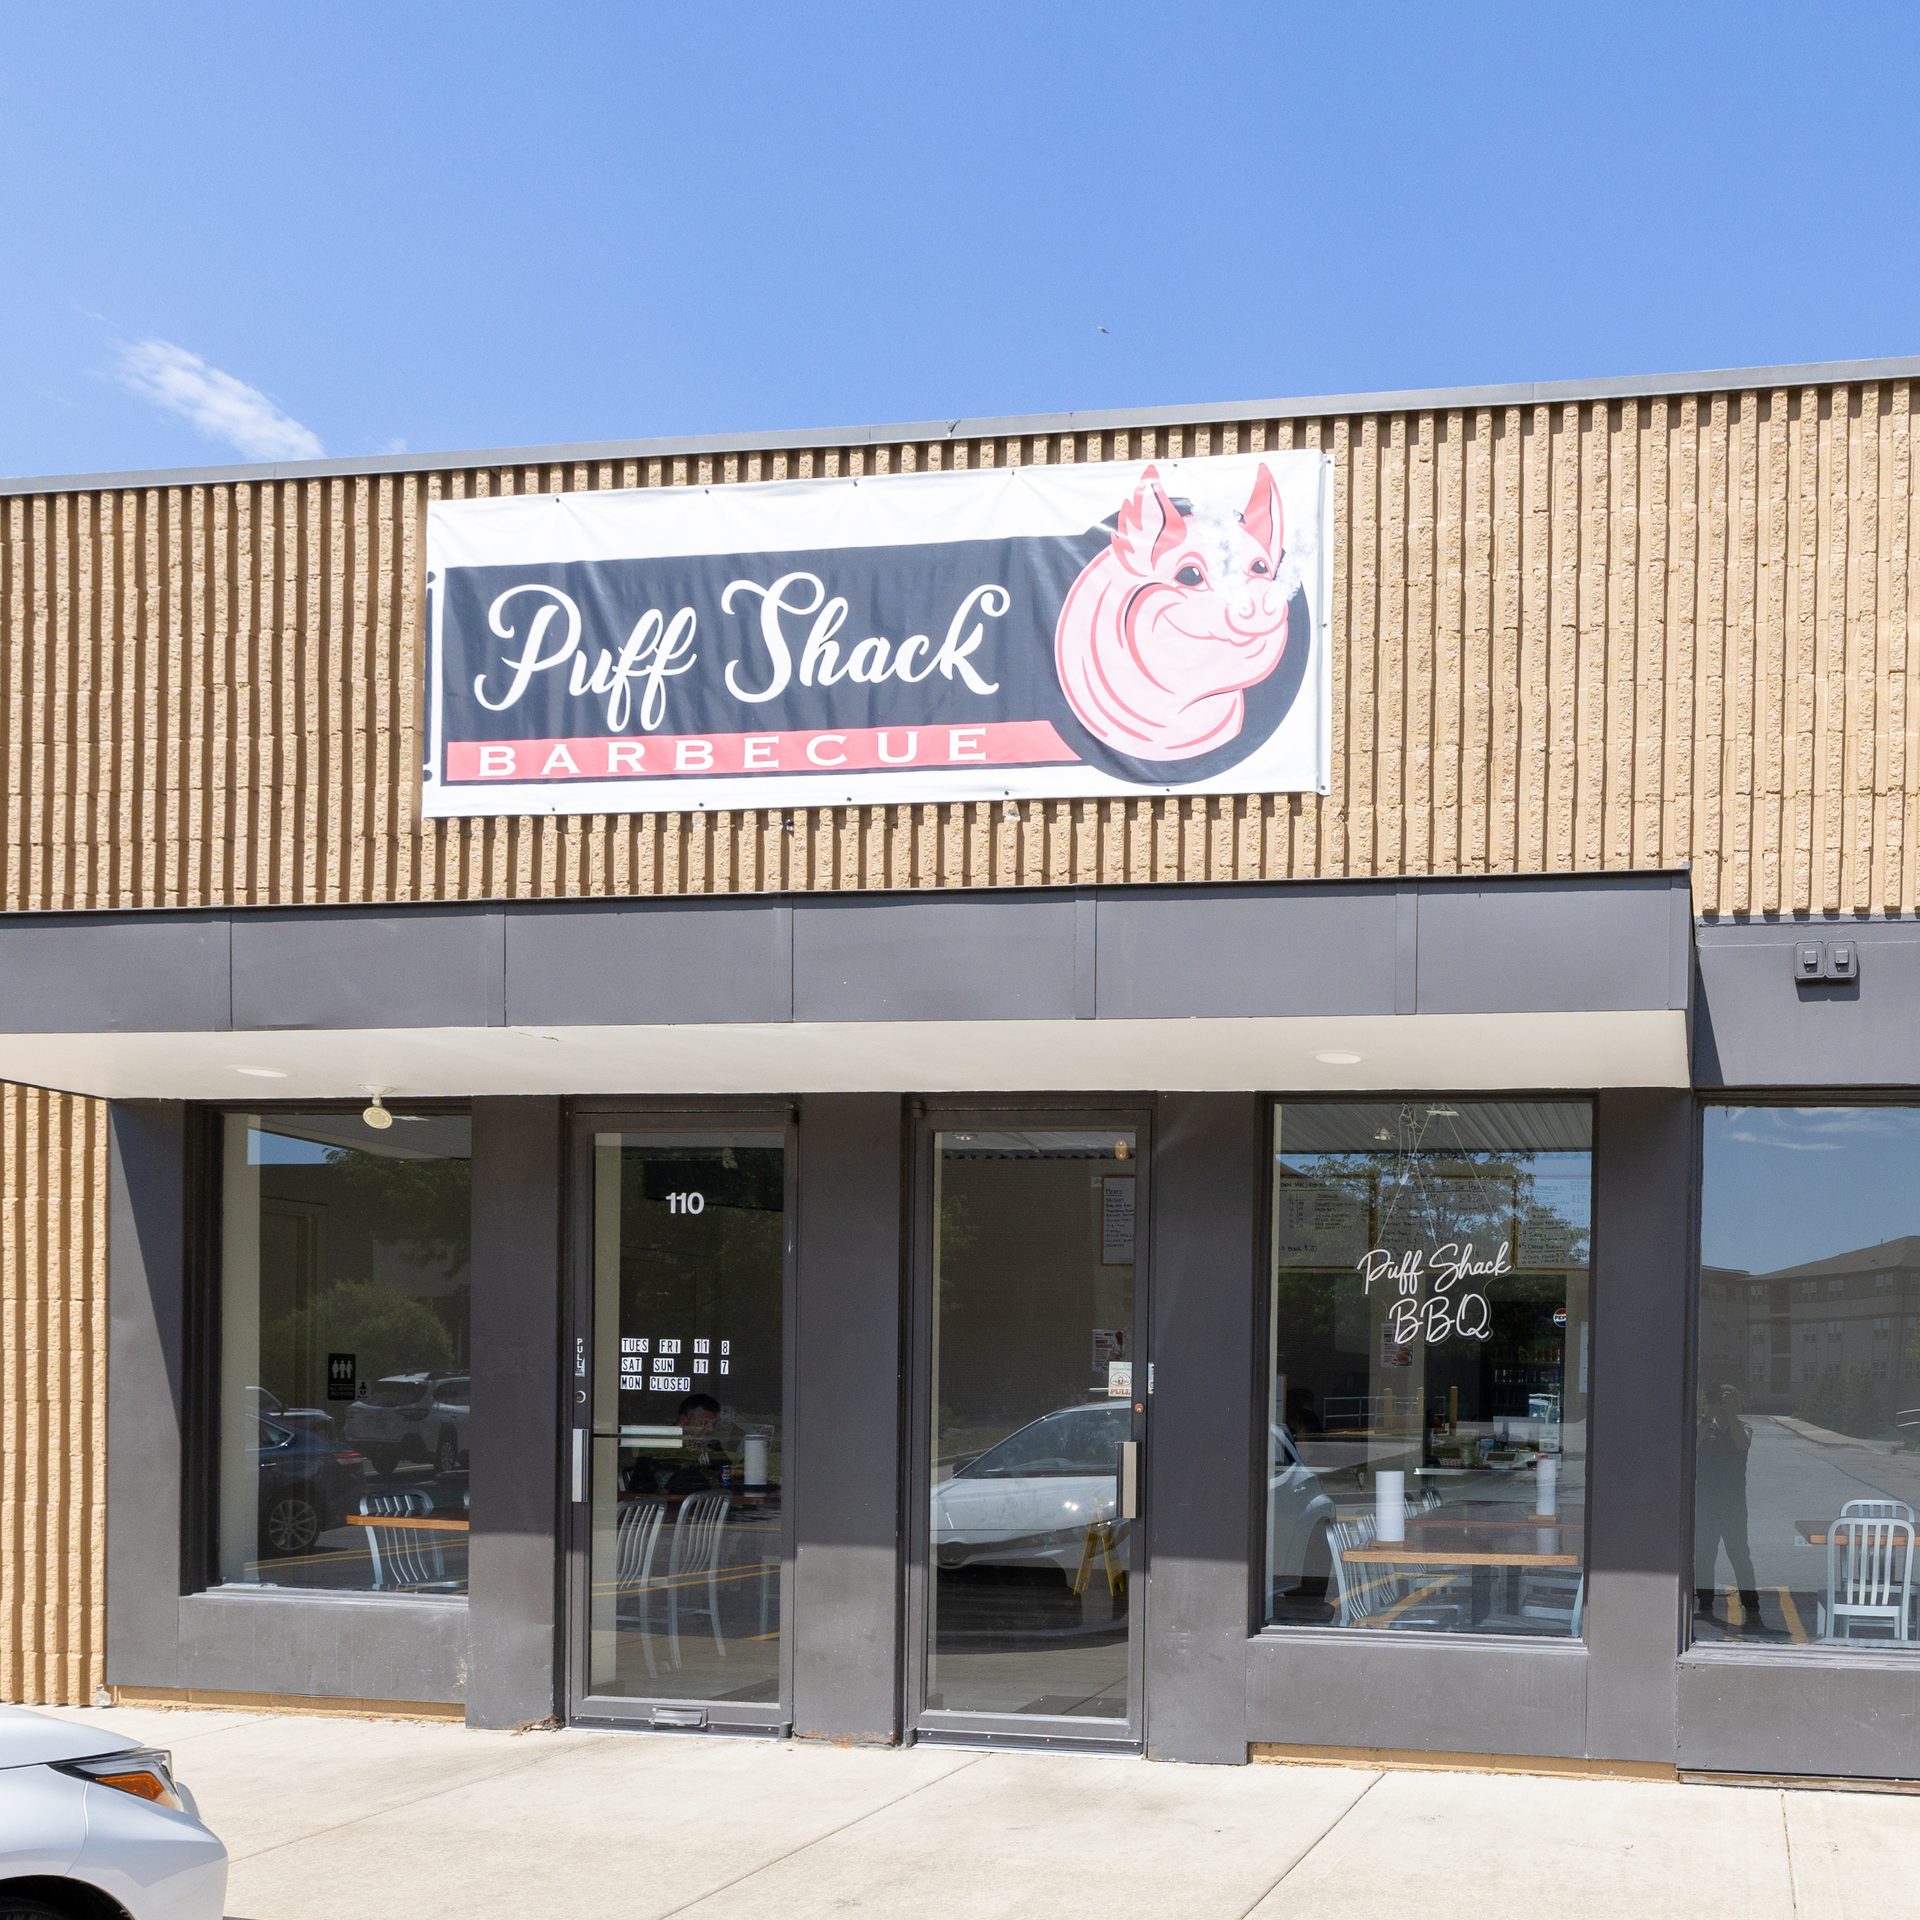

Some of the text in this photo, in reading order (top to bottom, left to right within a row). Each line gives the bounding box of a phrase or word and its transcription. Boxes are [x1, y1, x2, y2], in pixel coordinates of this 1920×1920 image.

[473, 571, 1011, 733] Puff Shack
[478, 726, 988, 778] BARBECUE
[665, 1192, 705, 1214] 110
[1356, 1241, 1511, 1295] Puff Shack
[1388, 1293, 1489, 1345] BBQ
[576, 1337, 584, 1369] PULL
[622, 1339, 729, 1354] TUES FRI 11 8
[622, 1358, 728, 1374] SAT SUN 11 7
[621, 1376, 690, 1390] MON CLOSED
